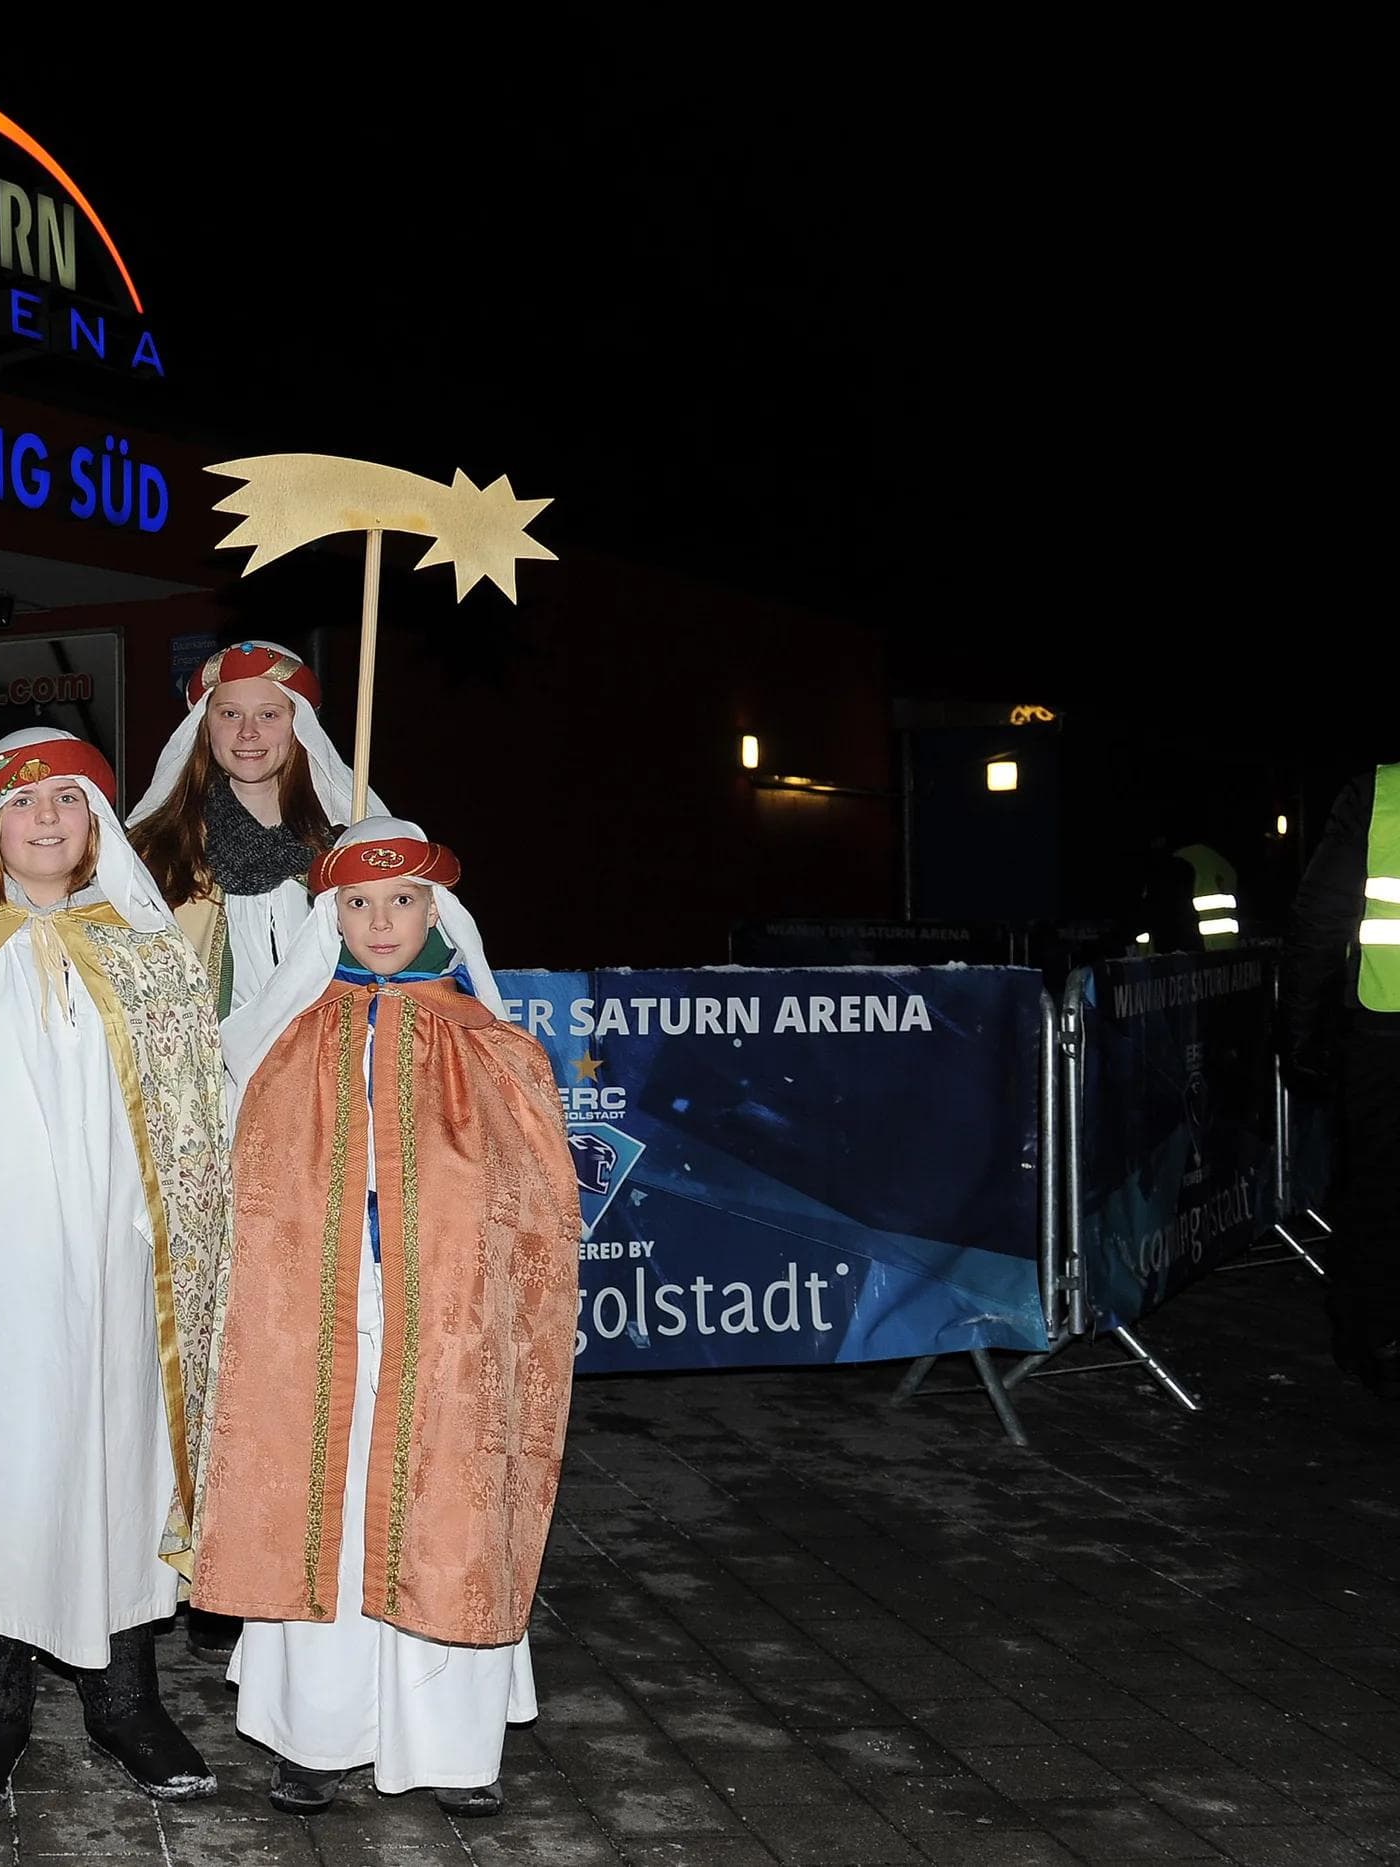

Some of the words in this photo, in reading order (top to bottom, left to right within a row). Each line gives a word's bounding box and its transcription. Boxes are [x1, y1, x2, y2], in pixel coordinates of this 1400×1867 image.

[69, 432, 170, 535] SÜD
[569, 997, 760, 1036] SATURN
[773, 995, 933, 1034] ARENA
[628, 1240, 655, 1258] BY
